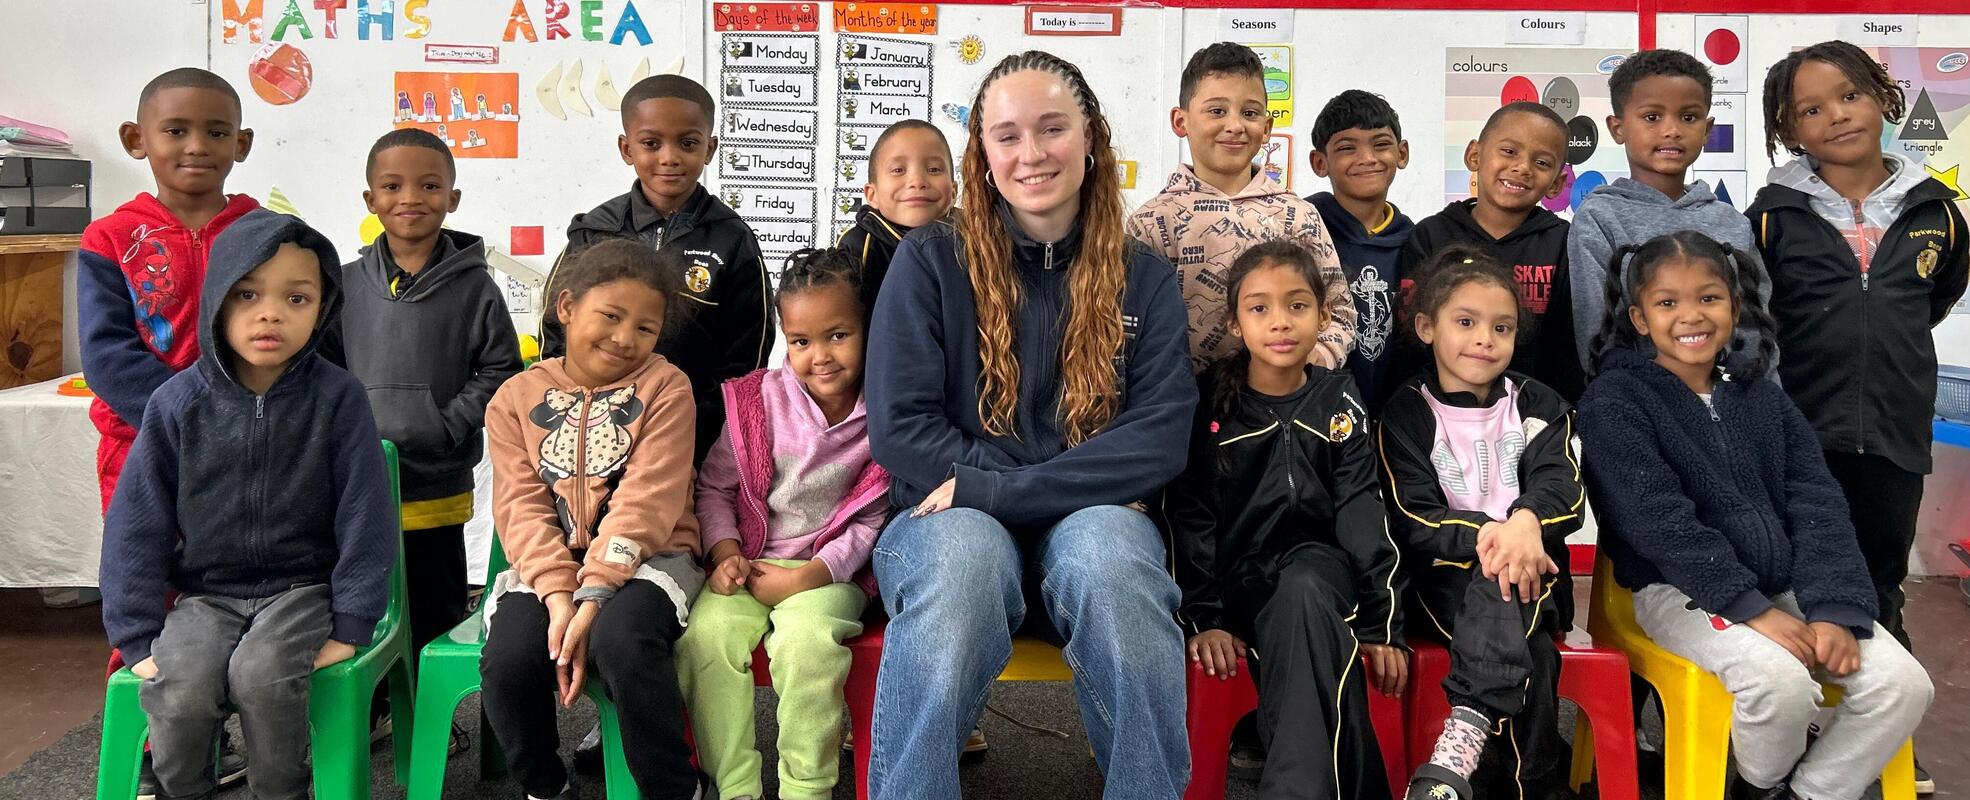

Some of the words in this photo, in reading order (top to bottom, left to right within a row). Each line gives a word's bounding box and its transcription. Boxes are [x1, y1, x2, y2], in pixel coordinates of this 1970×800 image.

[222, 0, 432, 44] MATHS
[502, 0, 653, 46] AREA
[716, 10, 750, 31] Days
[756, 9, 769, 25] of
[776, 9, 793, 25] the
[797, 10, 818, 26] week
[835, 9, 883, 28] Months
[886, 13, 898, 28] of
[901, 14, 917, 27] the
[919, 16, 936, 32] year
[1040, 18, 1067, 28] Today
[1069, 18, 1077, 27] is
[1231, 18, 1277, 30] Seasons
[1520, 18, 1566, 30] Colours
[1863, 22, 1903, 35] Shapes
[756, 44, 808, 64] Monday
[870, 47, 924, 65] January
[1452, 55, 1508, 73] colours
[748, 80, 801, 98] Tuesday
[864, 73, 921, 92] February
[870, 102, 911, 116] March
[1549, 96, 1572, 108] grey
[736, 117, 812, 138] Wednesday
[1912, 118, 1936, 131] grey
[1903, 141, 1944, 157] triangle
[752, 155, 811, 175] Thursday
[755, 195, 795, 214] Friday
[1193, 204, 1230, 213] AWAITS
[752, 229, 811, 249] Saturday
[1155, 215, 1172, 248] EXPLORE
[1182, 245, 1205, 256] HERO
[1513, 264, 1556, 284] SKAT
